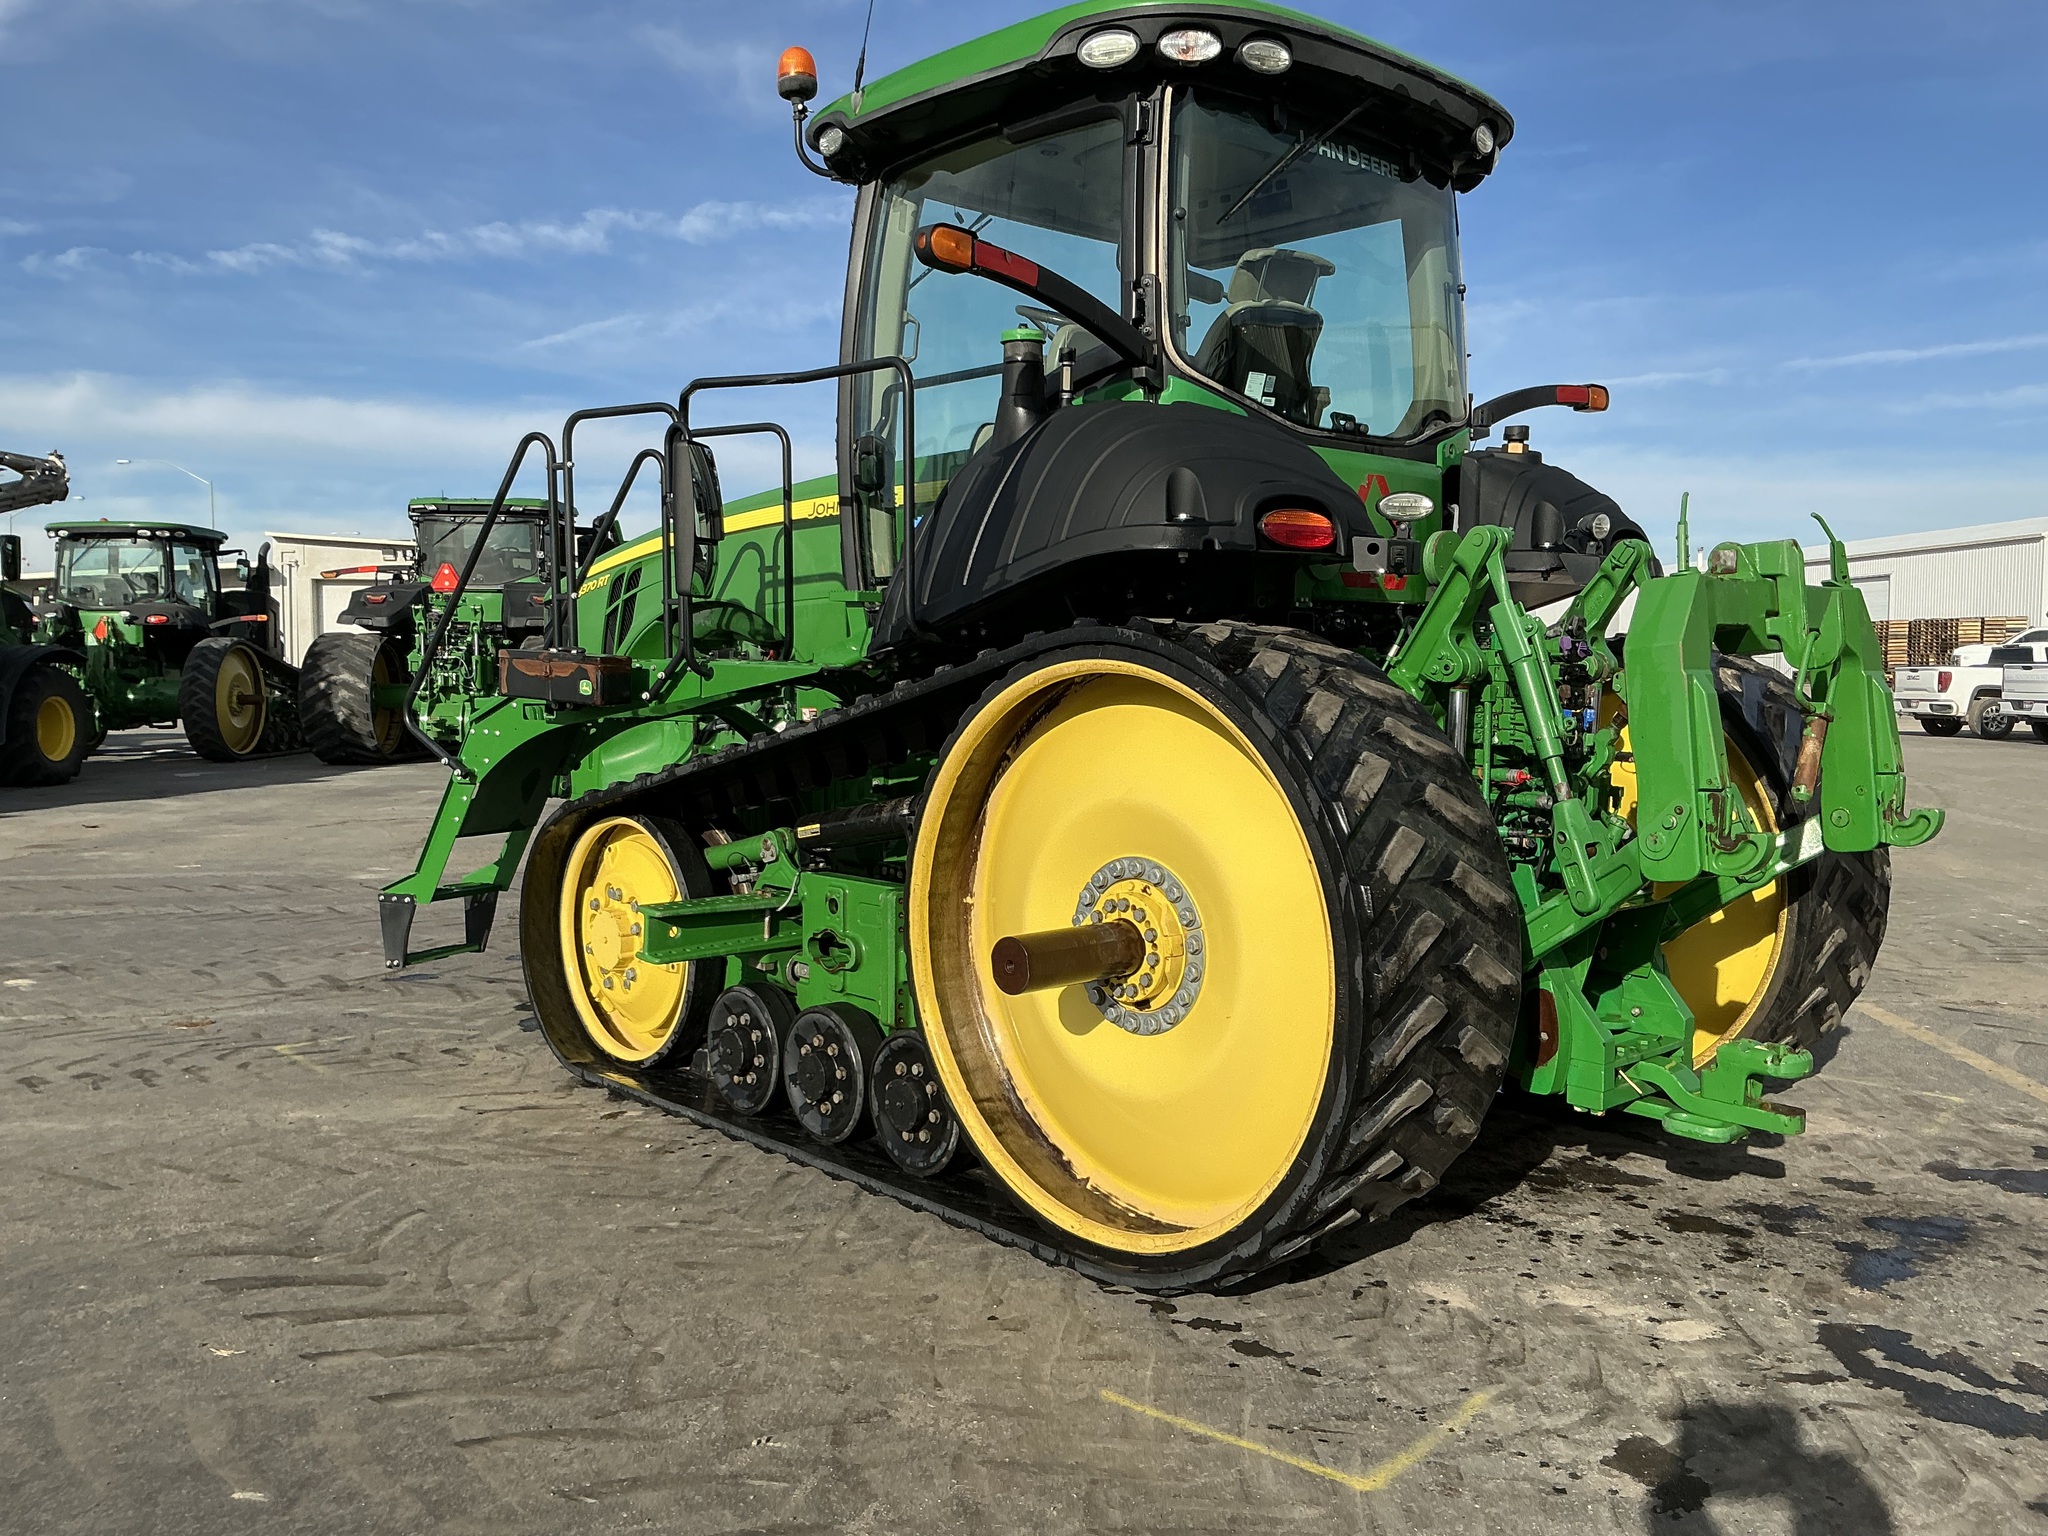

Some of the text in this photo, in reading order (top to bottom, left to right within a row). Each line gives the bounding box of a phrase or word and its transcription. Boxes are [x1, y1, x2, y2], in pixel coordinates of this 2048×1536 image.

[1295, 130, 1400, 181] JHN DEERE
[597, 574, 611, 589] RT
